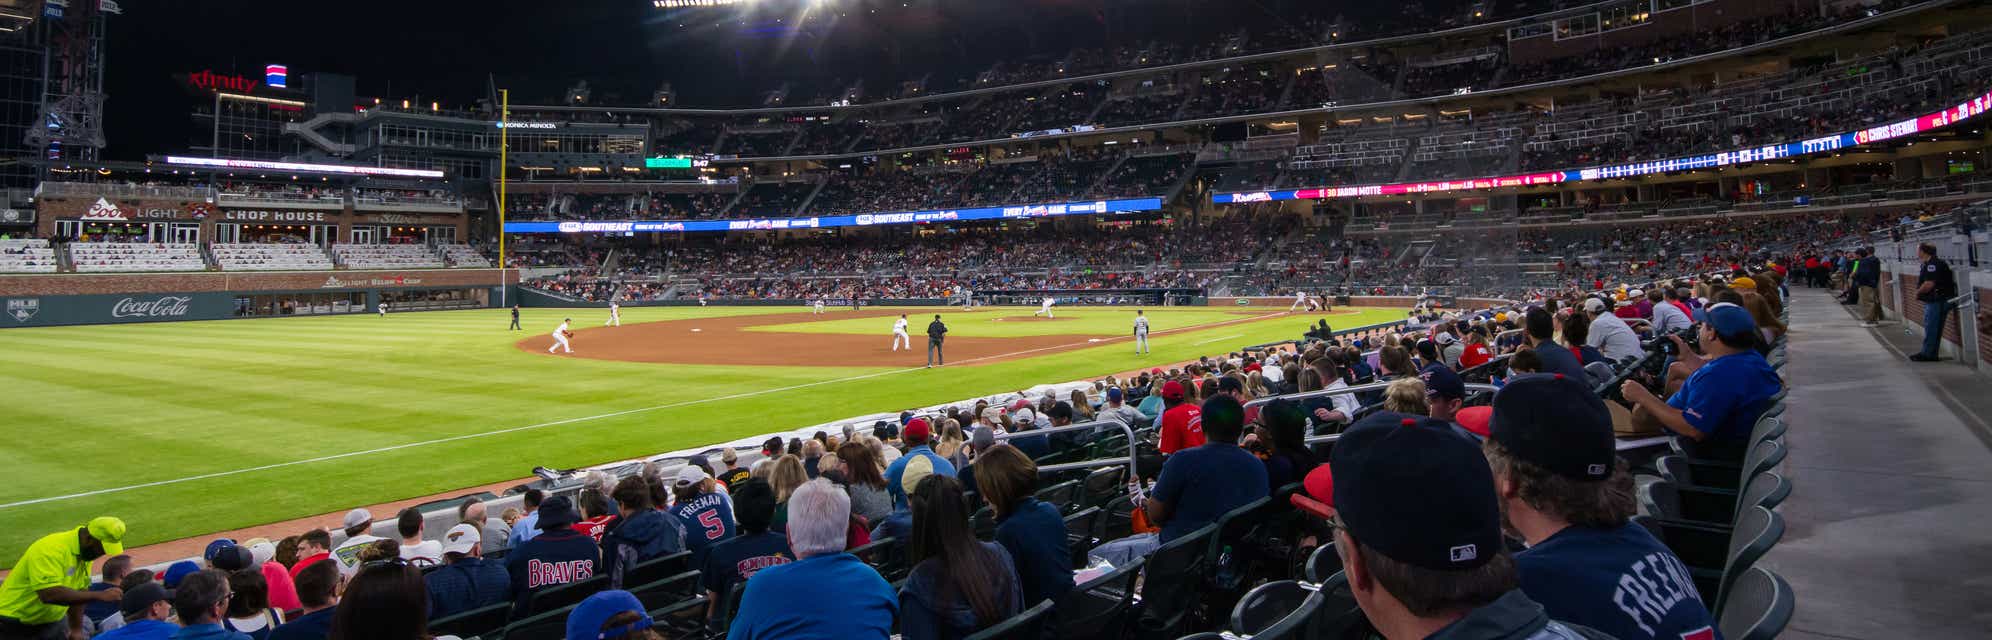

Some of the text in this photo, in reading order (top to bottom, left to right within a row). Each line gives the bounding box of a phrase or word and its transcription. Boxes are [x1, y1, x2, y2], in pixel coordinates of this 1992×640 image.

[504, 121, 557, 129] KONICA MINOLTA
[1860, 130, 1868, 143] 19
[1868, 125, 1891, 141] CHRIS
[1890, 118, 1919, 138] STEWART
[1359, 186, 1382, 195] MOTTE
[136, 208, 178, 218] LIGHT
[226, 210, 325, 221] CHOP HOUSE
[1003, 207, 1023, 217] EVERY
[1048, 204, 1066, 214] GAME
[874, 213, 914, 223] SOUTHEAST
[582, 222, 633, 232] SOUTHEAST
[679, 495, 721, 519] FREEMAN
[698, 508, 726, 540] 5
[528, 559, 594, 588] BRAVES
